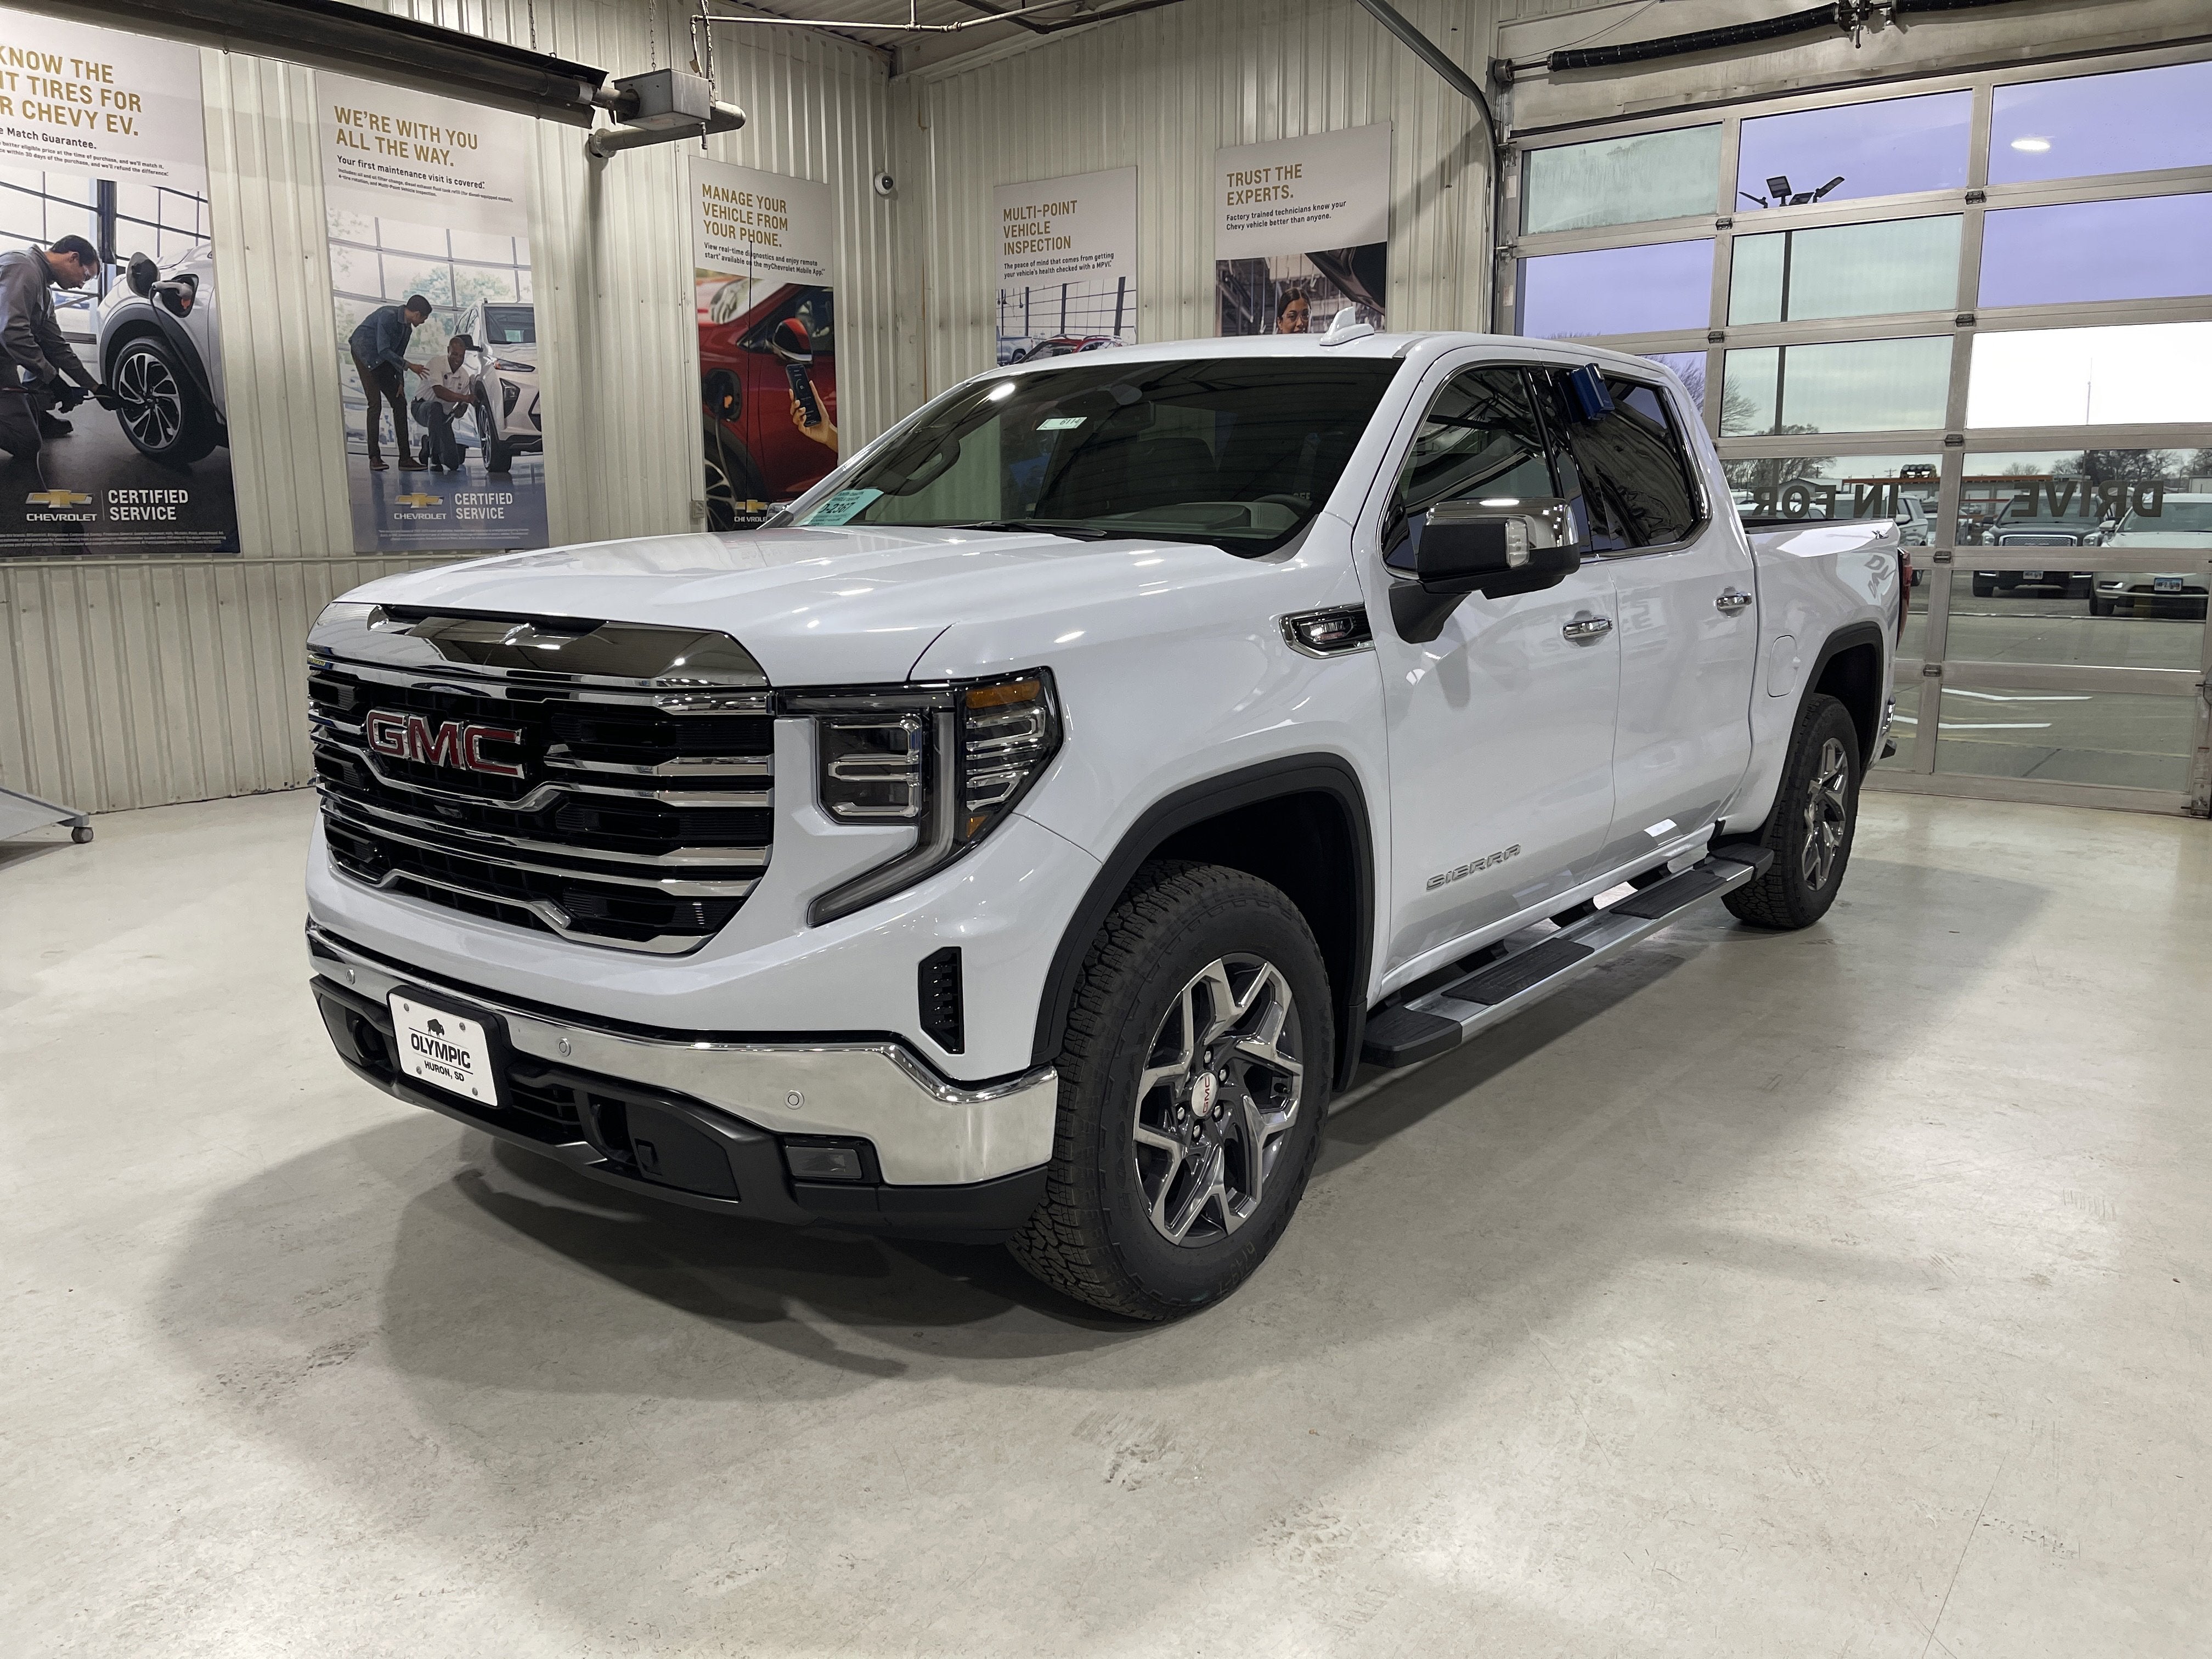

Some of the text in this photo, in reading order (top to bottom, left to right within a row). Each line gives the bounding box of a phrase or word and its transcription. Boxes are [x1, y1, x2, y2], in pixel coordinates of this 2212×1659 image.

[70, 58, 114, 84] THE
[26, 75, 93, 104] TIRES
[100, 88, 142, 112] FOR
[22, 100, 99, 129] CHEVY
[106, 114, 138, 136] EV.
[334, 105, 478, 150] WE'RE WITH YOU
[7, 127, 38, 140] Match
[42, 133, 97, 149] Guarantee.
[336, 128, 454, 167] ALL THE WAY.
[337, 155, 356, 166] Your
[358, 159, 375, 170] first
[377, 165, 427, 180] maintenance
[428, 173, 444, 183] visit
[446, 176, 453, 184] is
[1227, 163, 1302, 188] TRUST THE
[702, 183, 787, 214] MANAGE YOUR
[1227, 184, 1294, 206] EXPERTS.
[702, 201, 788, 231] VEHICLE FROM
[1003, 200, 1077, 222] MULTI-POINT
[1251, 210, 1273, 219] trained
[1275, 205, 1311, 216] technicians
[1331, 201, 1347, 210] your
[703, 219, 782, 247] YOUR PHONE.
[1003, 221, 1051, 238] VEHICLE
[1226, 223, 1245, 231] Chevy
[1246, 219, 1268, 228] vehicle
[1269, 218, 1289, 226] better
[1306, 213, 1331, 222] anyone.
[704, 241, 718, 251] View
[719, 246, 744, 256] real-time
[745, 250, 774, 261] dignostics
[786, 257, 799, 266] enjoy
[1004, 235, 1071, 256] INSPECTION
[721, 256, 745, 264] available
[763, 263, 795, 272] myChevrolet
[1094, 252, 1114, 262] getting
[1016, 268, 1038, 276] vehicle's
[1056, 264, 1077, 273] checked
[108, 489, 189, 504] CERTIFIED
[455, 493, 513, 505] CERTIFIED
[26, 513, 97, 522] CHEVROLET
[110, 506, 177, 521] SERVICE
[456, 507, 505, 520] SERVICE
[366, 709, 525, 780] GMC
[1426, 844, 1521, 890] SIERRA
[410, 1033, 471, 1069] OLYMPIC
[424, 1060, 465, 1082] HURON, SD
